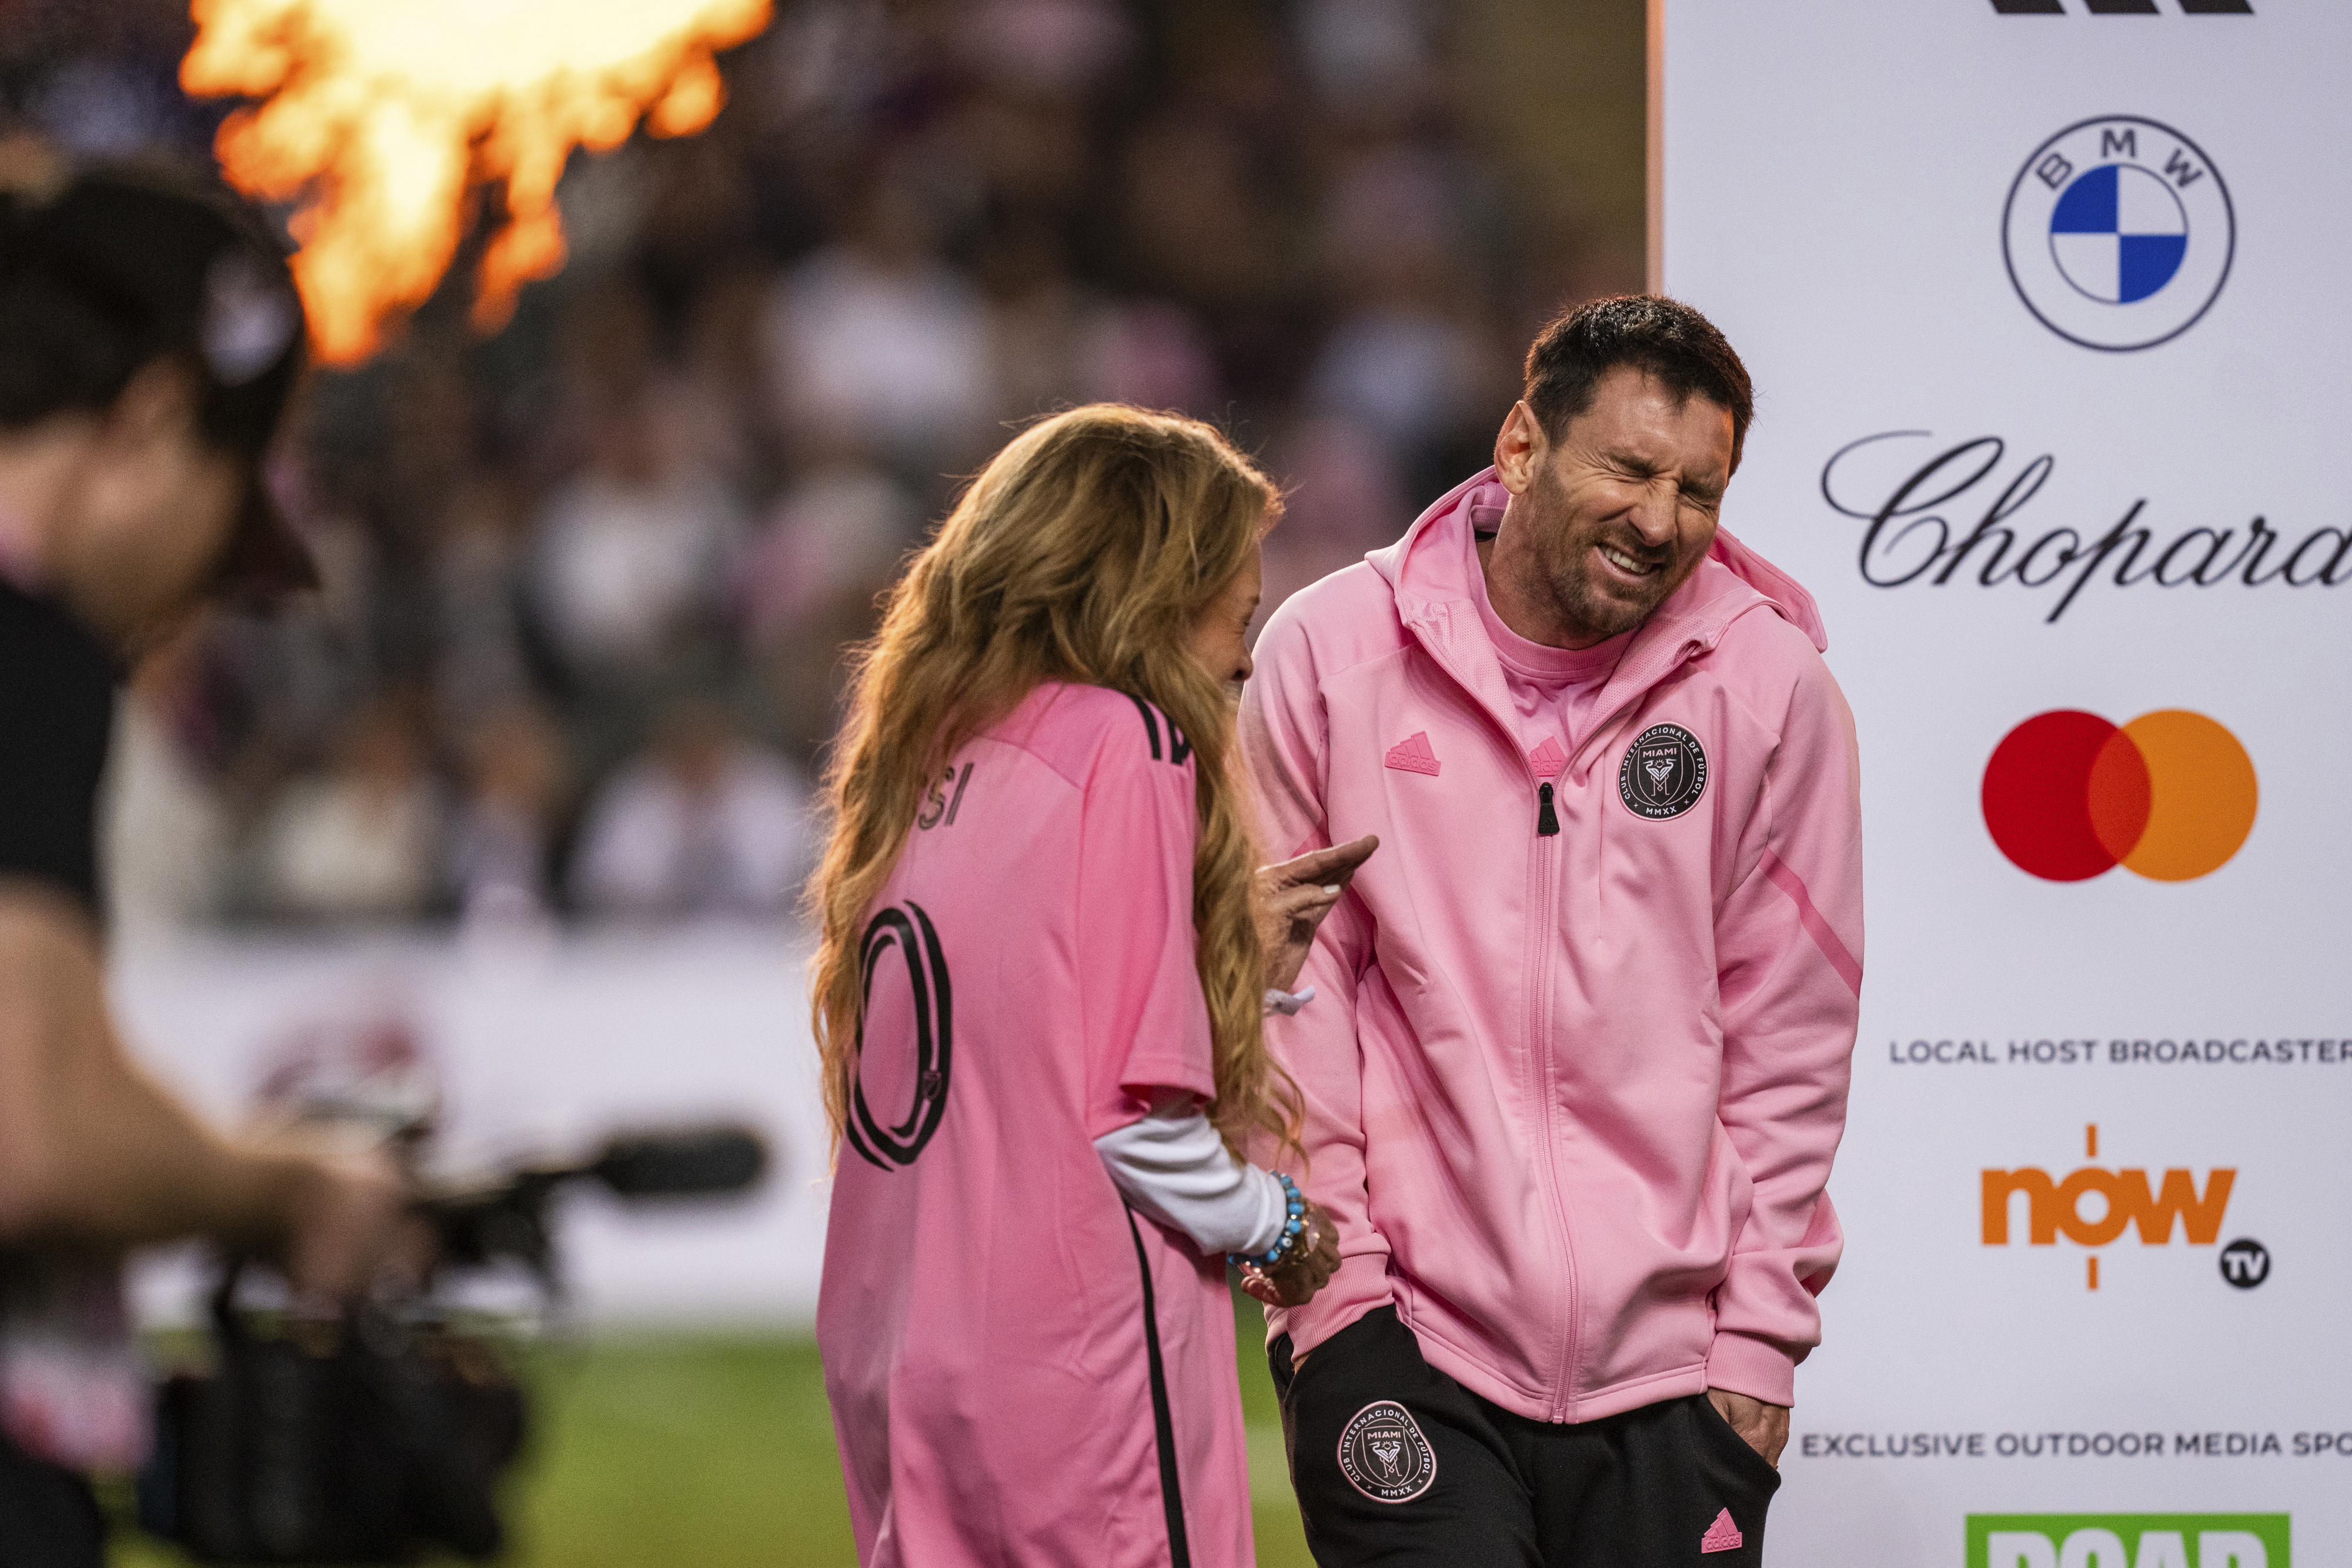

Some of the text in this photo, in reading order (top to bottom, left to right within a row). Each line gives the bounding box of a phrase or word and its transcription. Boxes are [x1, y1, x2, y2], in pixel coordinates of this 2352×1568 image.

[2036, 128, 2204, 193] BMW
[1389, 755, 1437, 771] adidas
[1621, 727, 1706, 799] CLUB INTERNACIONAL DE FÚTBOL
[1642, 747, 1677, 758] MIAMI
[1646, 805, 1677, 815] MMXX
[1889, 1039, 1997, 1064] LOCAL
[2007, 1039, 2098, 1064] HOST
[1981, 1166, 2237, 1247] now
[2224, 1251, 2264, 1280] TV
[1342, 1409, 1431, 1482] CLUB INTERNACIONAL DE FÚTBOL
[1367, 1431, 1401, 1440] MIAMI
[1801, 1433, 1985, 1457] EXCLUSIVE
[1995, 1432, 2165, 1457] OUTDOOR
[2174, 1432, 2282, 1456] MEDIA
[1381, 1485, 1413, 1496] MMXX
[1705, 1536, 1740, 1550] adidas
